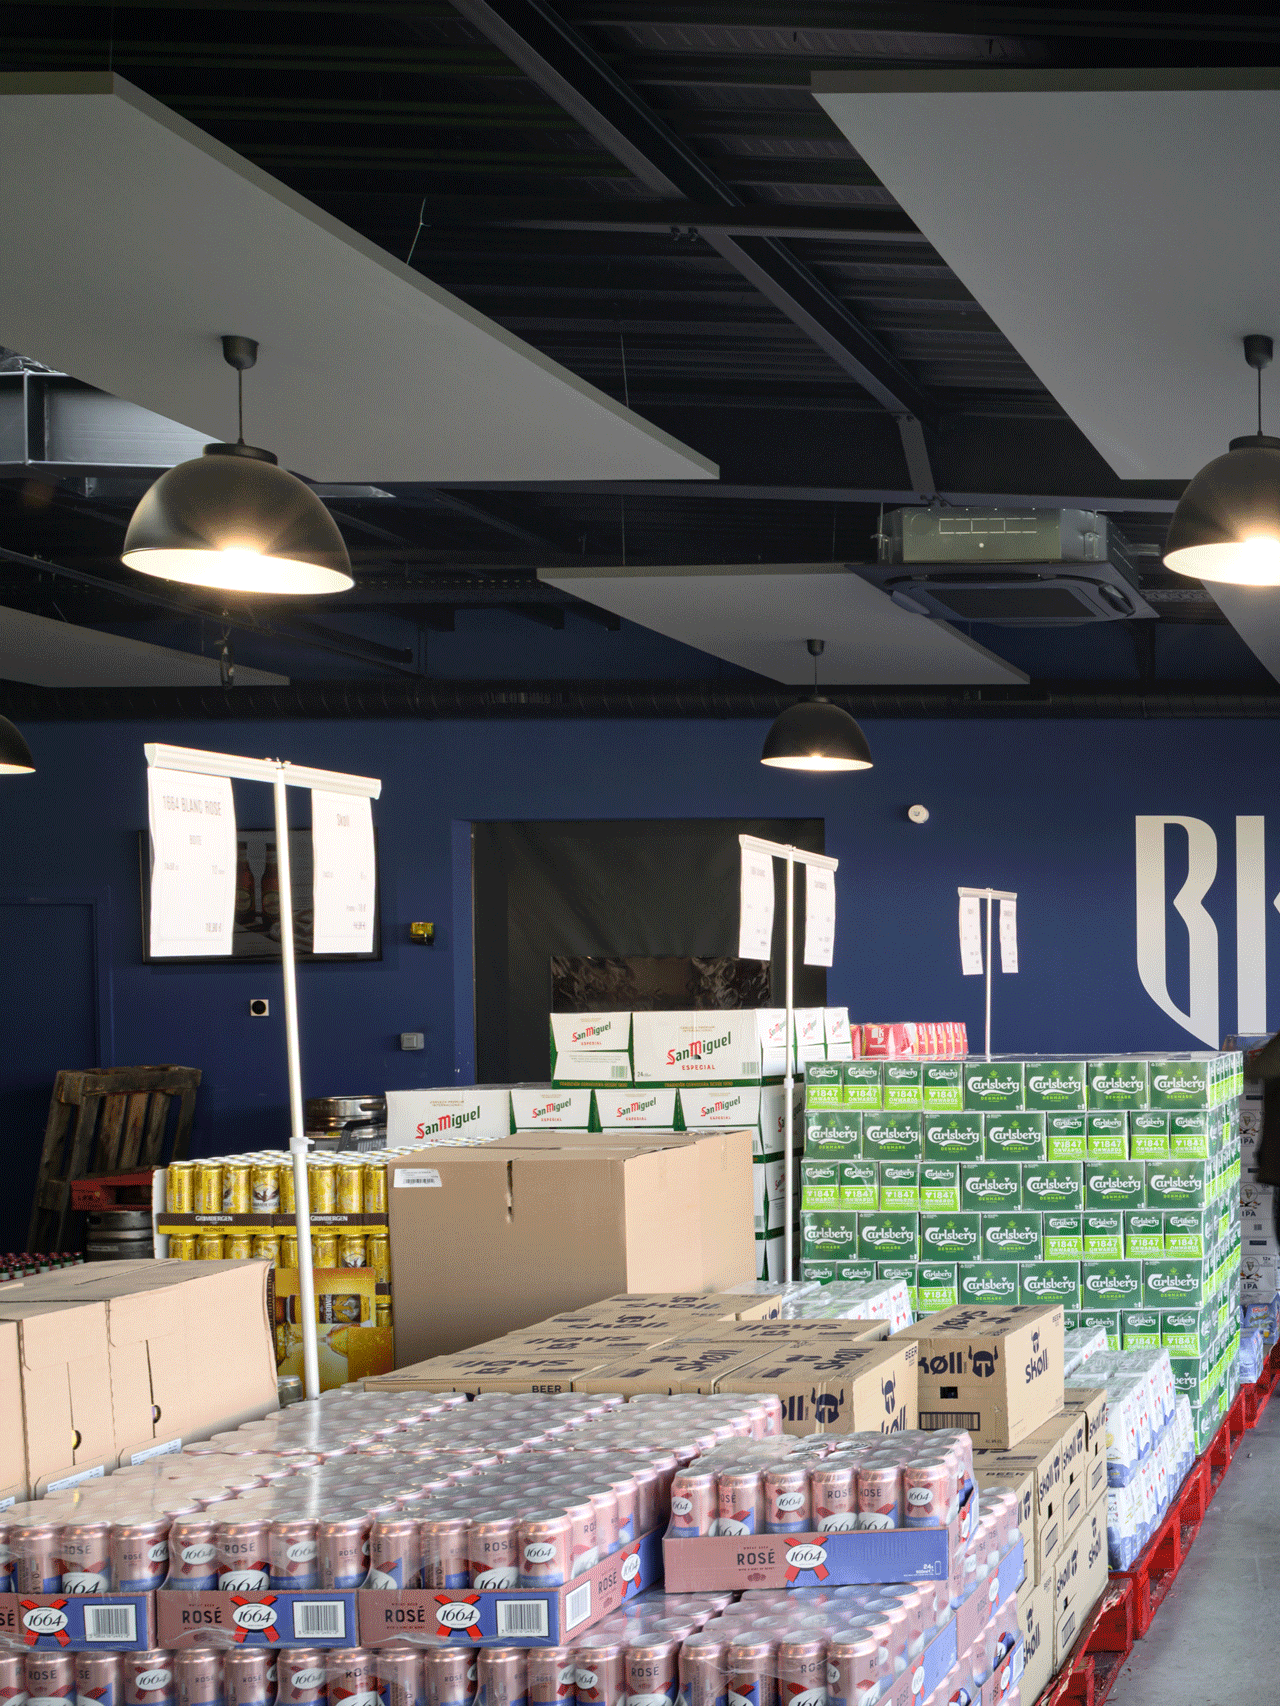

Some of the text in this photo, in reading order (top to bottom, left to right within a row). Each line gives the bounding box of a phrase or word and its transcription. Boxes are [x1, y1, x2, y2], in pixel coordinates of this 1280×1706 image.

[809, 1067, 837, 1078] Carlsberg
[848, 1067, 877, 1078] Carlsberg
[889, 1068, 917, 1079] Carlsberg
[929, 1069, 957, 1080] Carlsberg
[968, 1077, 1019, 1096] Carlsberg
[1030, 1076, 1081, 1095] Carlsberg
[1092, 1076, 1143, 1095] Carlsberg
[1154, 1075, 1205, 1094] Carlsberg
[896, 1090, 917, 1098] 1847
[1053, 1118, 1081, 1129] Carlsberg
[1093, 1118, 1121, 1129] Carlsberg
[1136, 1117, 1164, 1128] Carlsberg
[1175, 1117, 1205, 1128] Carlsberg
[808, 1126, 857, 1144] Carlsberg
[867, 1126, 918, 1145] Carlsberg
[928, 1127, 979, 1146] Carlsberg
[989, 1127, 1041, 1146] Carlsberg
[806, 1168, 834, 1179] Carlsberg
[844, 1168, 873, 1179] Carlsberg
[885, 1168, 914, 1179] Carlsberg
[925, 1169, 953, 1180] Carlsberg
[966, 1177, 1017, 1196] Carlsberg
[1027, 1177, 1078, 1196] Carlsberg
[1090, 1176, 1140, 1195] Carlsberg
[1151, 1175, 1201, 1194] Carlsberg
[1049, 1218, 1078, 1229] Carlsberg
[1089, 1218, 1117, 1229] Carlsberg
[1131, 1217, 1159, 1228] Carlsberg
[1170, 1217, 1198, 1227] Carlsberg
[804, 1226, 852, 1244] Carlsberg
[862, 1226, 913, 1245] Carlsberg
[925, 1227, 976, 1246] Carlsberg
[986, 1227, 1037, 1246] Carlsberg
[1057, 1240, 1077, 1248] 1847
[805, 1269, 832, 1279] Carlsberg
[842, 1269, 871, 1279] Carlsberg
[884, 1269, 912, 1279] Carlsberg
[923, 1269, 952, 1280] Carlsberg
[963, 1277, 1014, 1296] Carlsberg
[1024, 1276, 1075, 1295] Carlsberg
[1087, 1275, 1137, 1294] Carlsberg
[1148, 1274, 1198, 1293] Carlsberg
[1086, 1318, 1114, 1327] Carlsberg
[1128, 1316, 1156, 1327] Carlsberg
[1167, 1316, 1195, 1326] Carlsberg
[905, 1346, 917, 1360] BEER
[532, 1385, 561, 1393] BEER
[778, 1497, 802, 1506] 1664
[908, 1492, 930, 1500] 1664
[672, 1501, 688, 1510] 664
[185, 1548, 215, 1559] 1664
[526, 1547, 552, 1557] 1664
[737, 1549, 775, 1565] ROSÉ
[790, 1550, 824, 1562] 1664
[0, 1610, 15, 1626] SÉ
[28, 1612, 64, 1626] 1664
[182, 1607, 222, 1623] ROSÉ
[238, 1609, 273, 1622] 1664
[385, 1606, 425, 1622] ROSÉ
[441, 1608, 478, 1621] 1664
[139, 1674, 171, 1686] 1664
